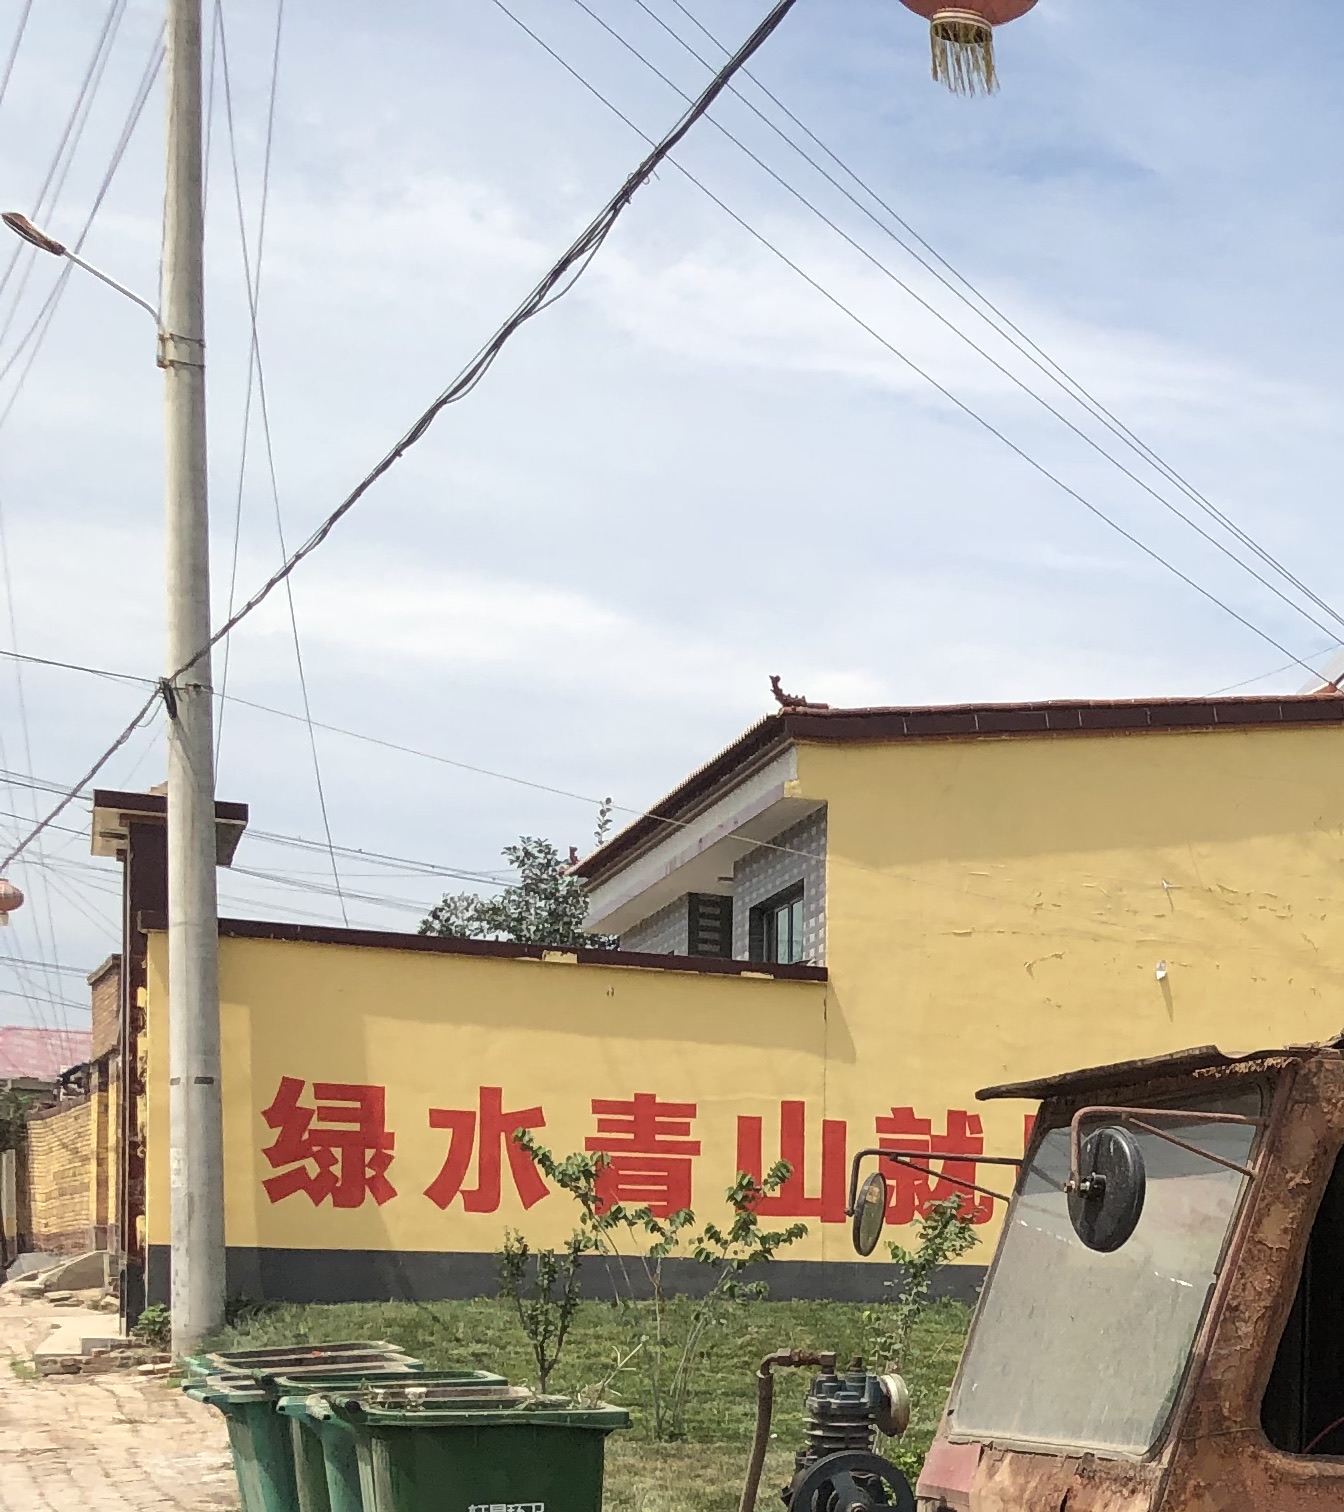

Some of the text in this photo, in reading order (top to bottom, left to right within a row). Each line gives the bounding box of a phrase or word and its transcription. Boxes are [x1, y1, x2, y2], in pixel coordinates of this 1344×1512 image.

[261, 1075, 1037, 1225] 绿水青山就
